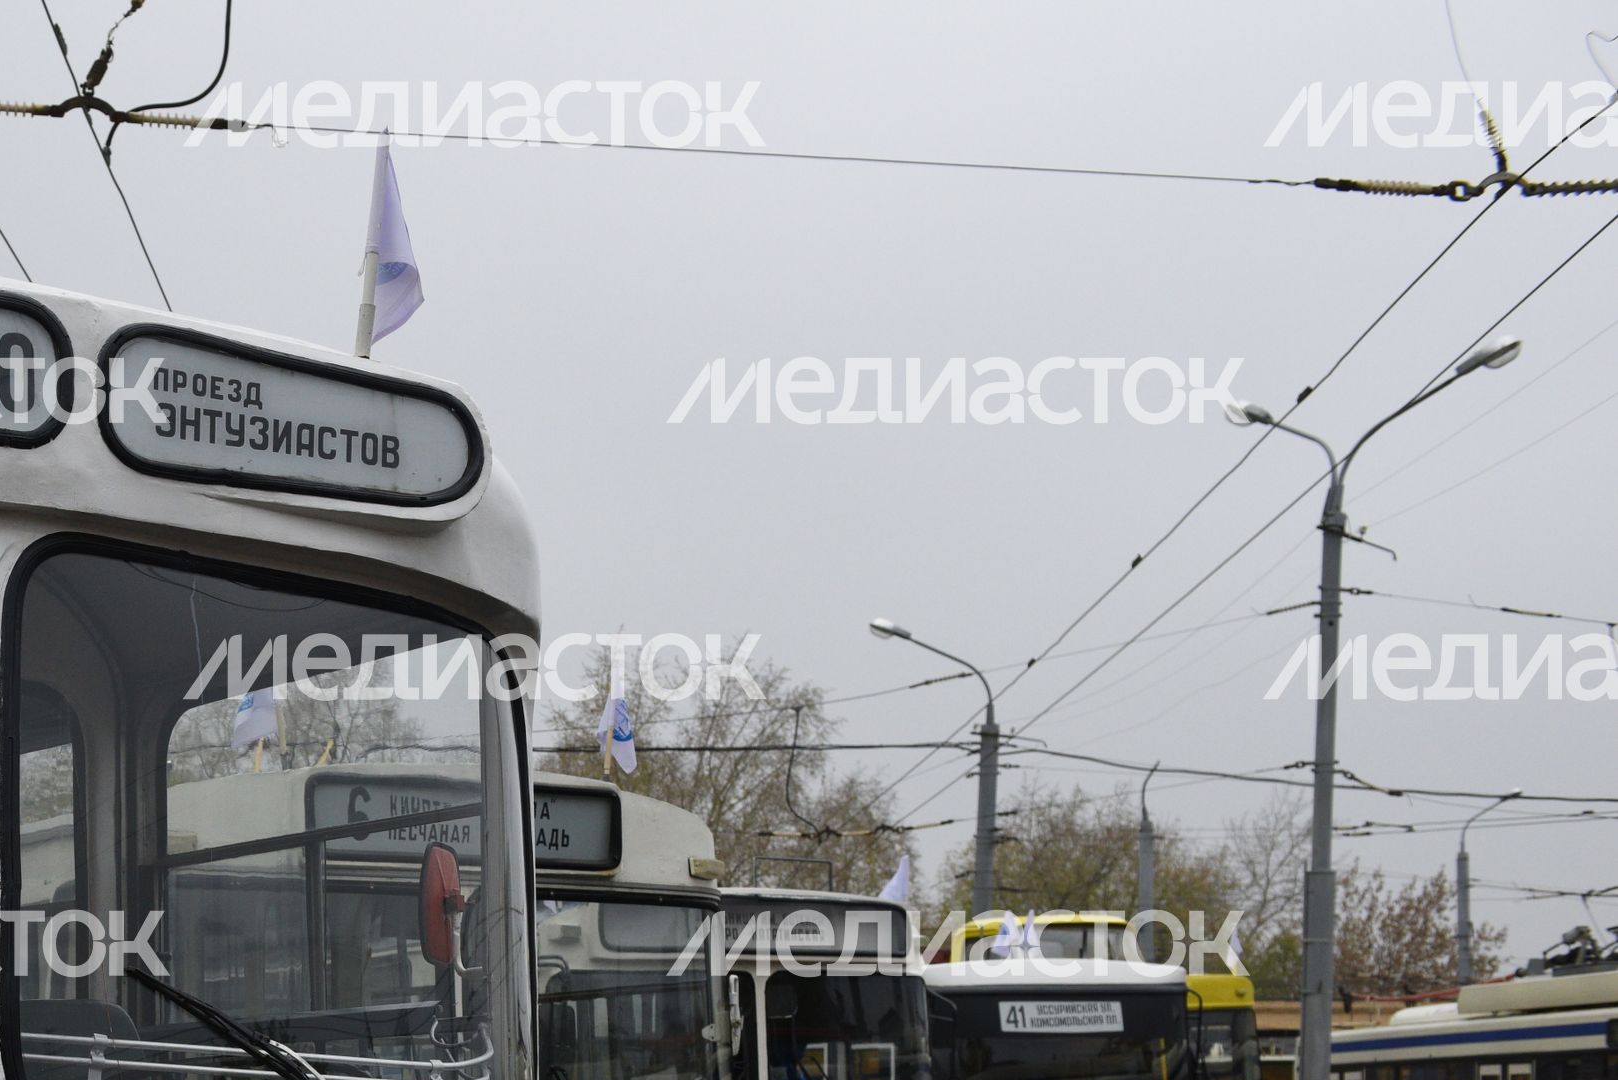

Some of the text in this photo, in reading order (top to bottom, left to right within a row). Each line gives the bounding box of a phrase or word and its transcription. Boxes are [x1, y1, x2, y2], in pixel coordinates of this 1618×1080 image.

[154, 367, 263, 410] ПРОЕЗД
[154, 402, 401, 469] ЭНТУЗИАСТОВ
[348, 786, 371, 841] 6
[1006, 1005, 1027, 1029] 41
